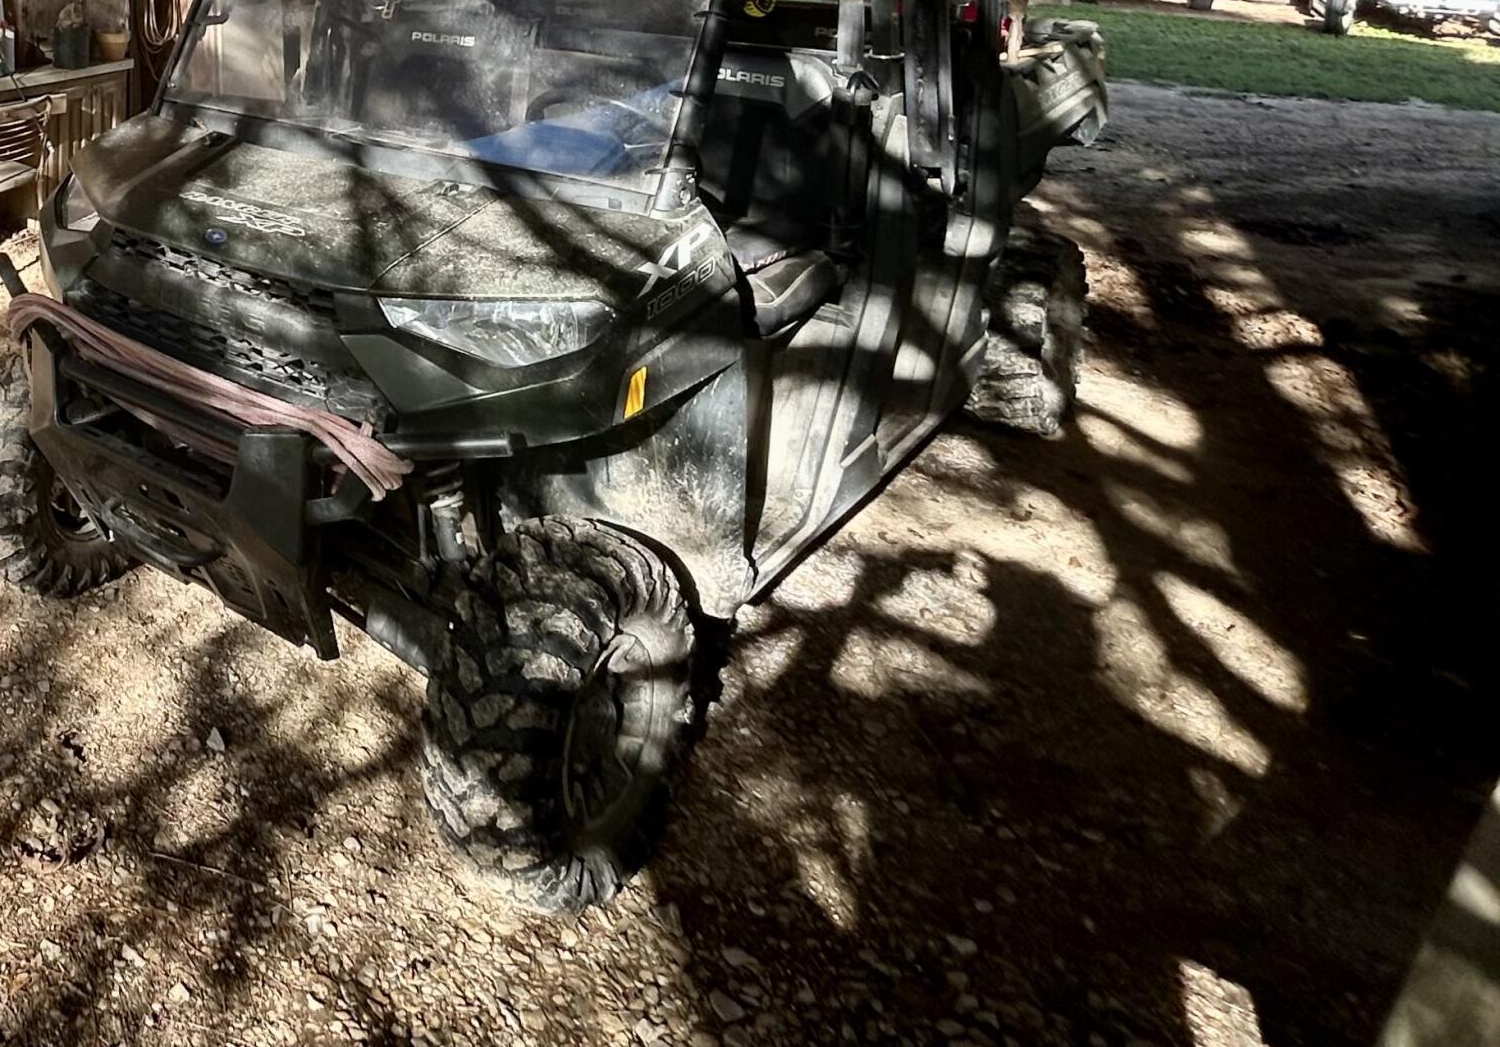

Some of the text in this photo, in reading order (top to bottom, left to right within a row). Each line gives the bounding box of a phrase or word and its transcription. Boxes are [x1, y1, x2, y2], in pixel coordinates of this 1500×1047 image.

[411, 31, 476, 47] POLARIS
[636, 222, 714, 299] XP
[647, 255, 716, 321] 1000
